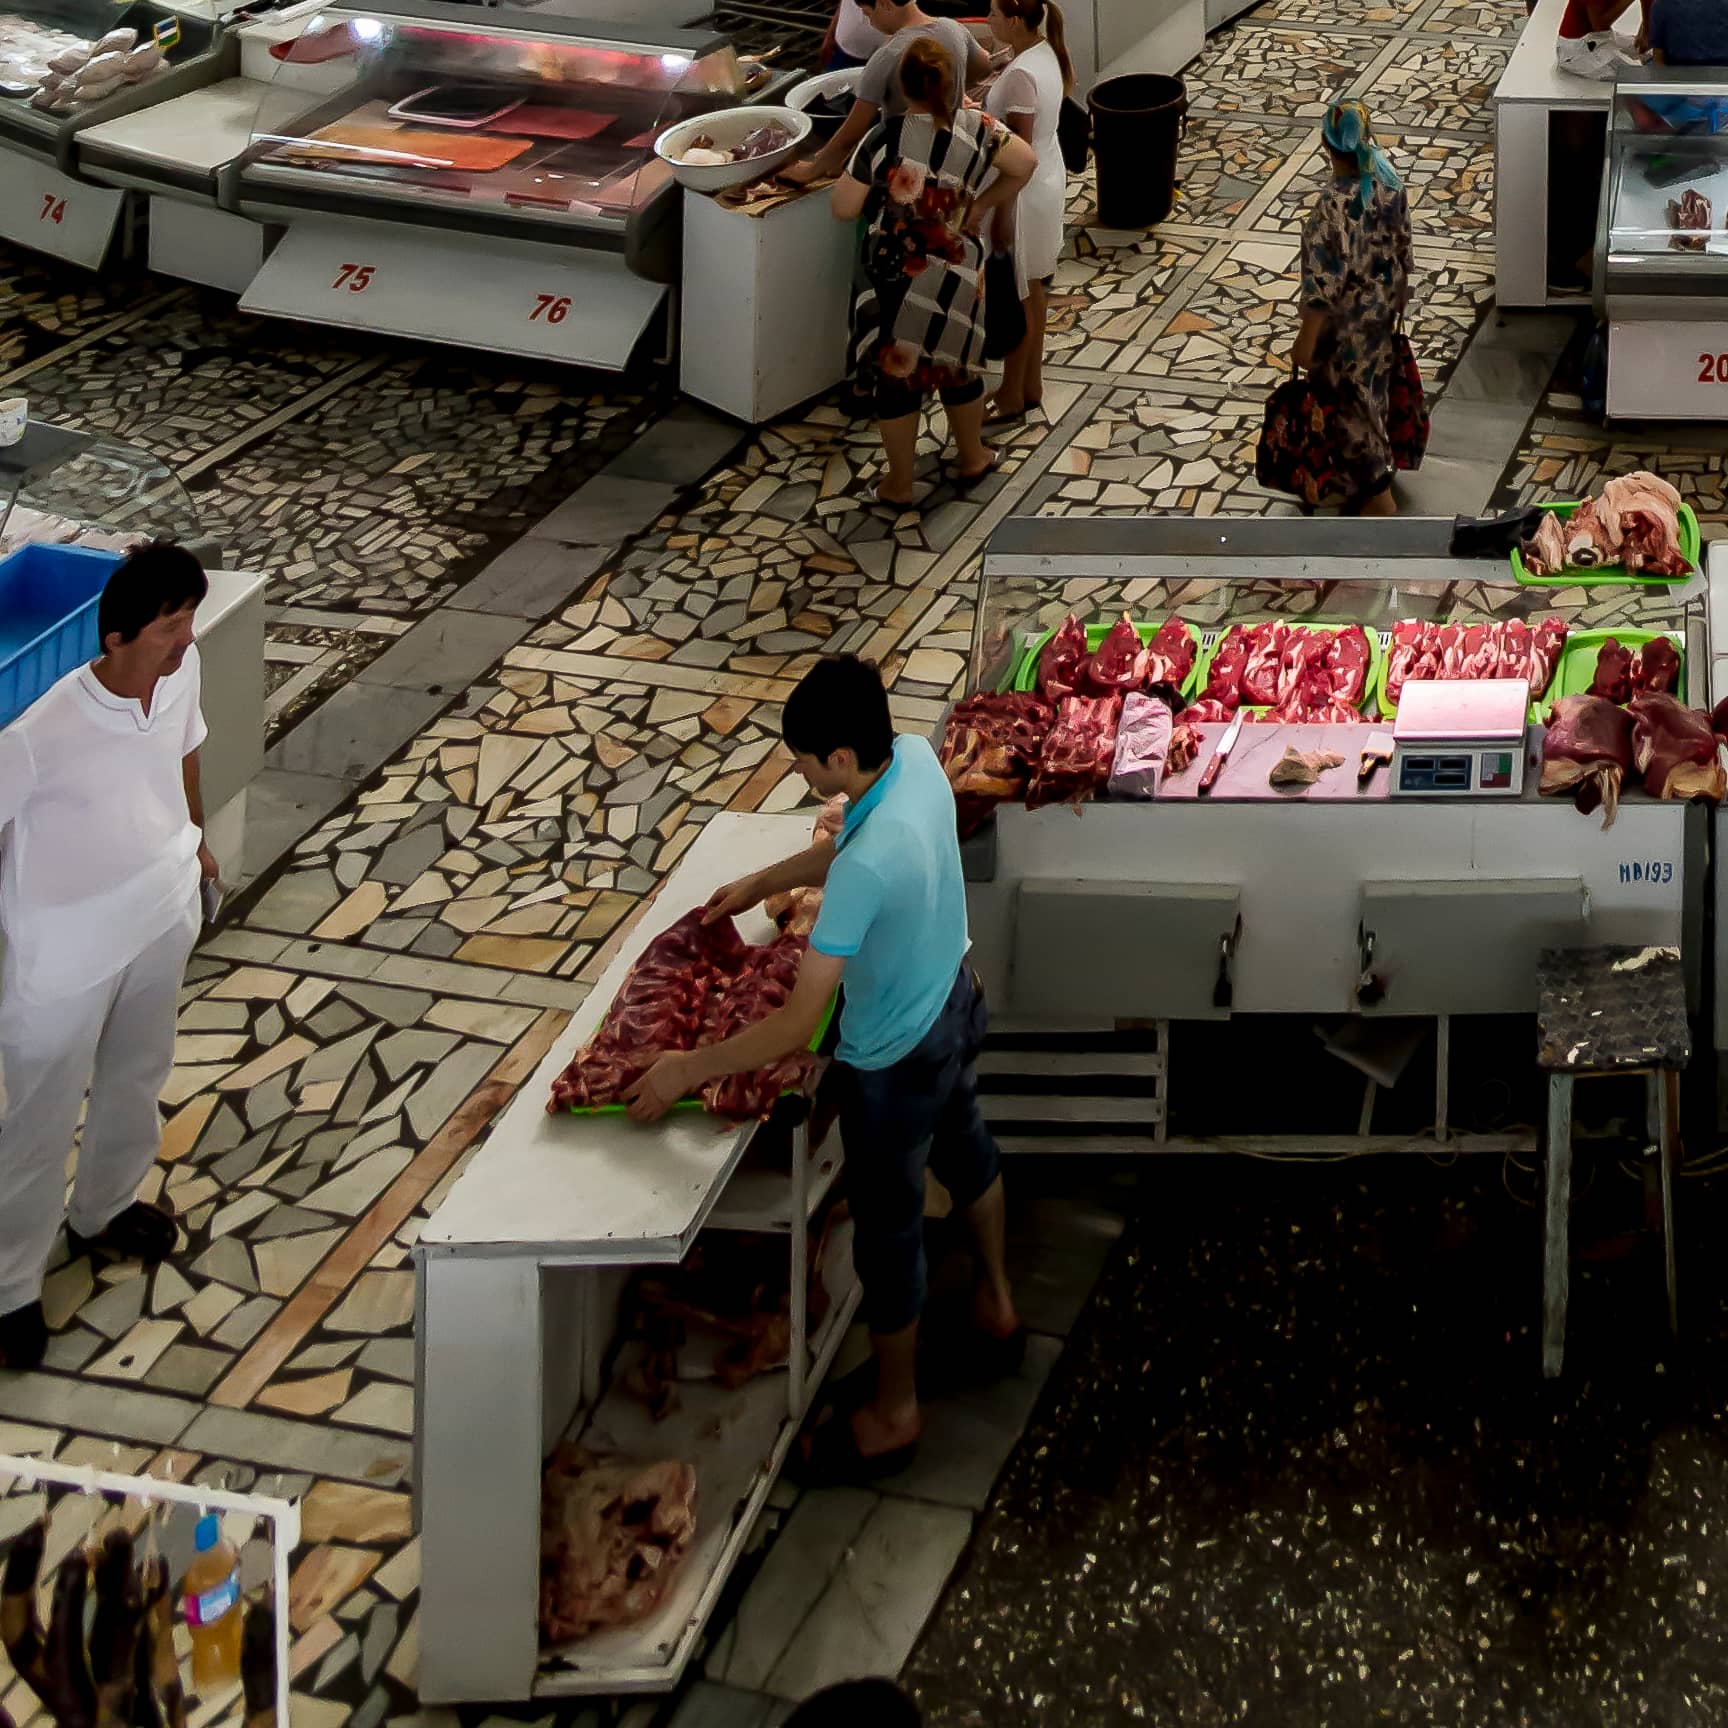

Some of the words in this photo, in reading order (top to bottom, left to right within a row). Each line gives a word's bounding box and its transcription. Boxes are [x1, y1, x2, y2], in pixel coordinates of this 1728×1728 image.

[40, 194, 67, 224] 74
[331, 263, 376, 292] 75
[528, 294, 573, 323] 76
